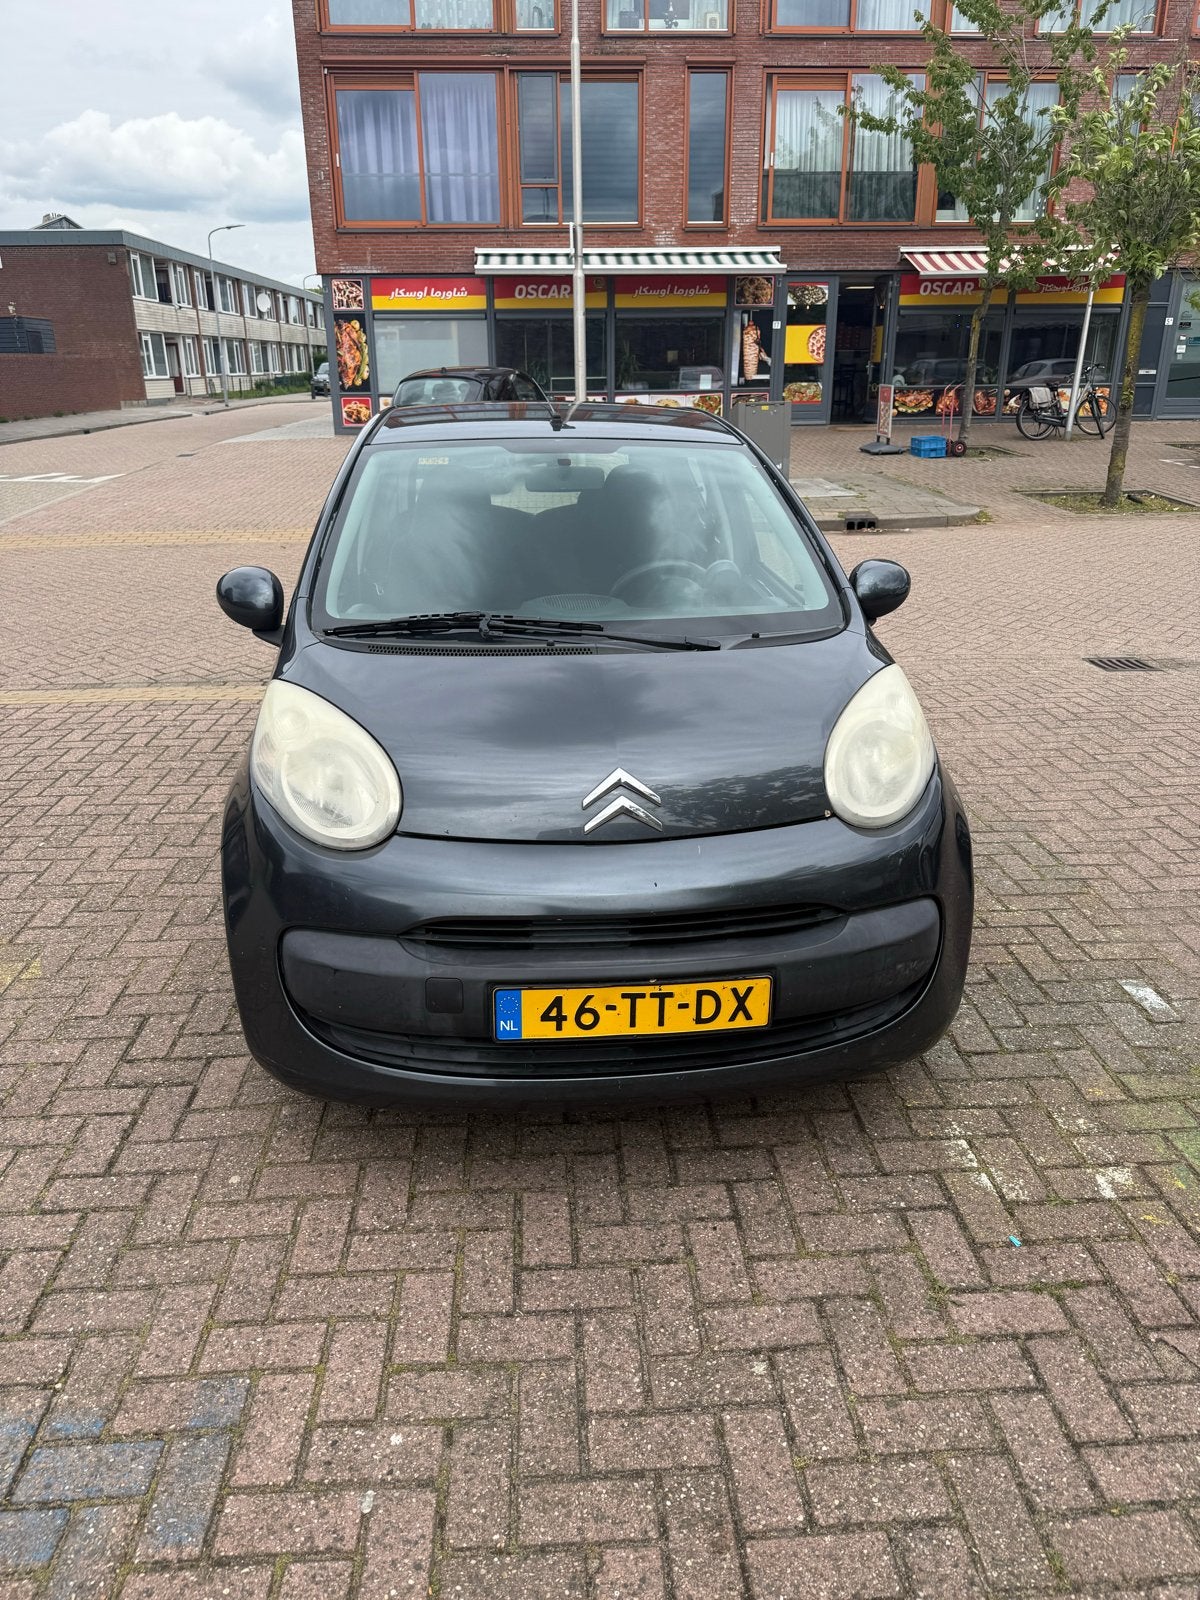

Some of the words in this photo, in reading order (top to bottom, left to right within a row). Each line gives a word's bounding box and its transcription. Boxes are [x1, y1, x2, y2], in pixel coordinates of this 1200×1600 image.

[430, 286, 468, 300] شاورما
[514, 284, 571, 299] OSCAR
[673, 284, 710, 297] شاورما
[919, 281, 975, 296] OSCAR
[540, 986, 754, 1032] 46-TT-DX
[500, 1020, 518, 1031] NL
